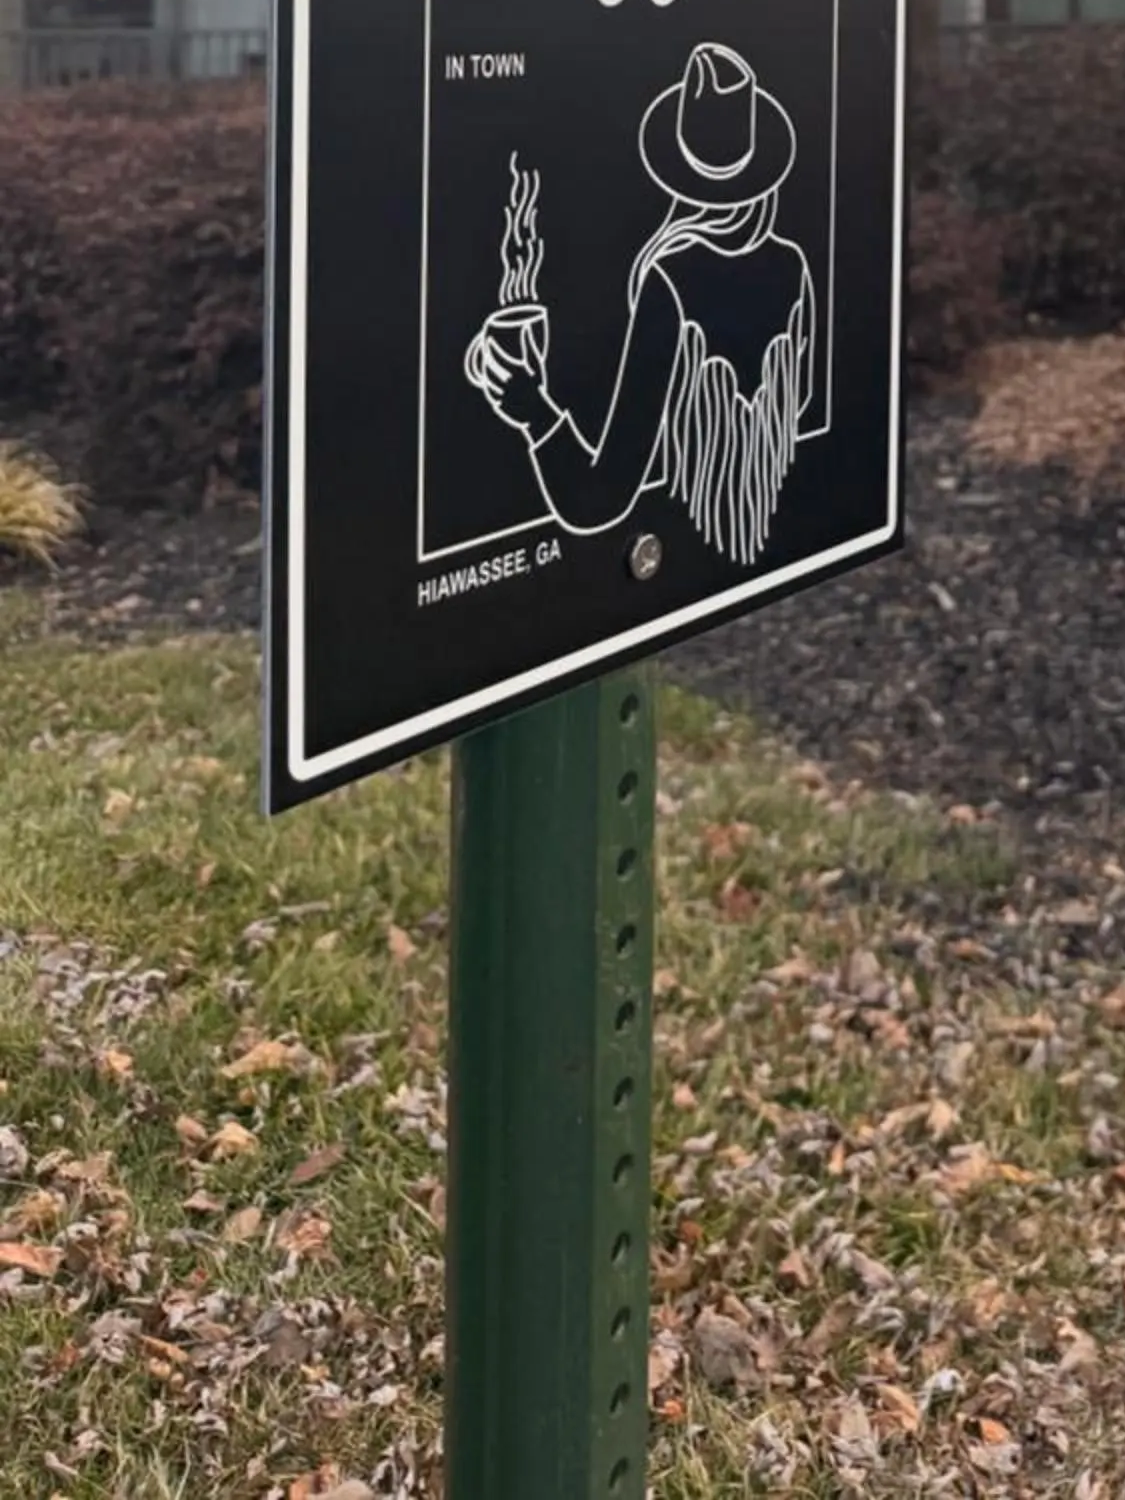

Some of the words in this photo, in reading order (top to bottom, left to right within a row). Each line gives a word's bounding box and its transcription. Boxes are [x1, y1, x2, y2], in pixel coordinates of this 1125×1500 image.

[445, 55, 464, 80] IN
[471, 53, 525, 78] TOWN
[417, 549, 531, 607] HIAWASSEE,
[535, 539, 562, 565] GA
